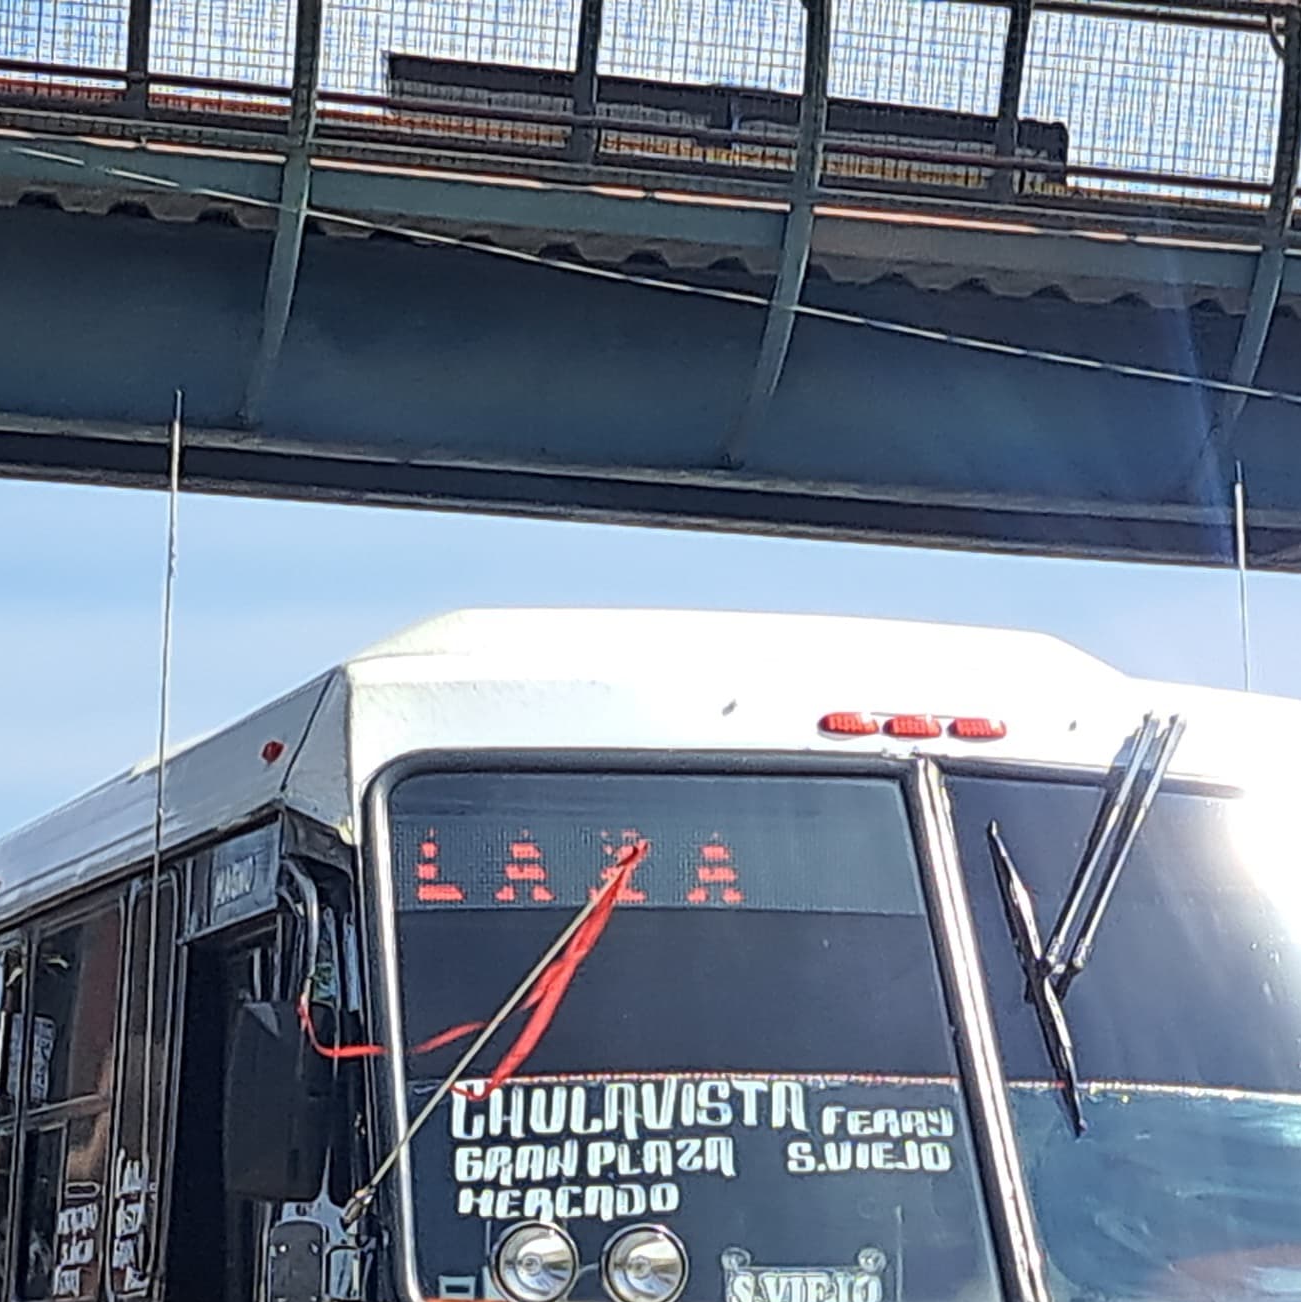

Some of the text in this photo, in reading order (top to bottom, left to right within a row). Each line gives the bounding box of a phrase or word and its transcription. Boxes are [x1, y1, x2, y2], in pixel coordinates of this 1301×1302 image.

[821, 1105, 954, 1138] FERRY
[787, 1140, 952, 1172] S.VIEJO
[457, 1182, 680, 1223] MERCADO
